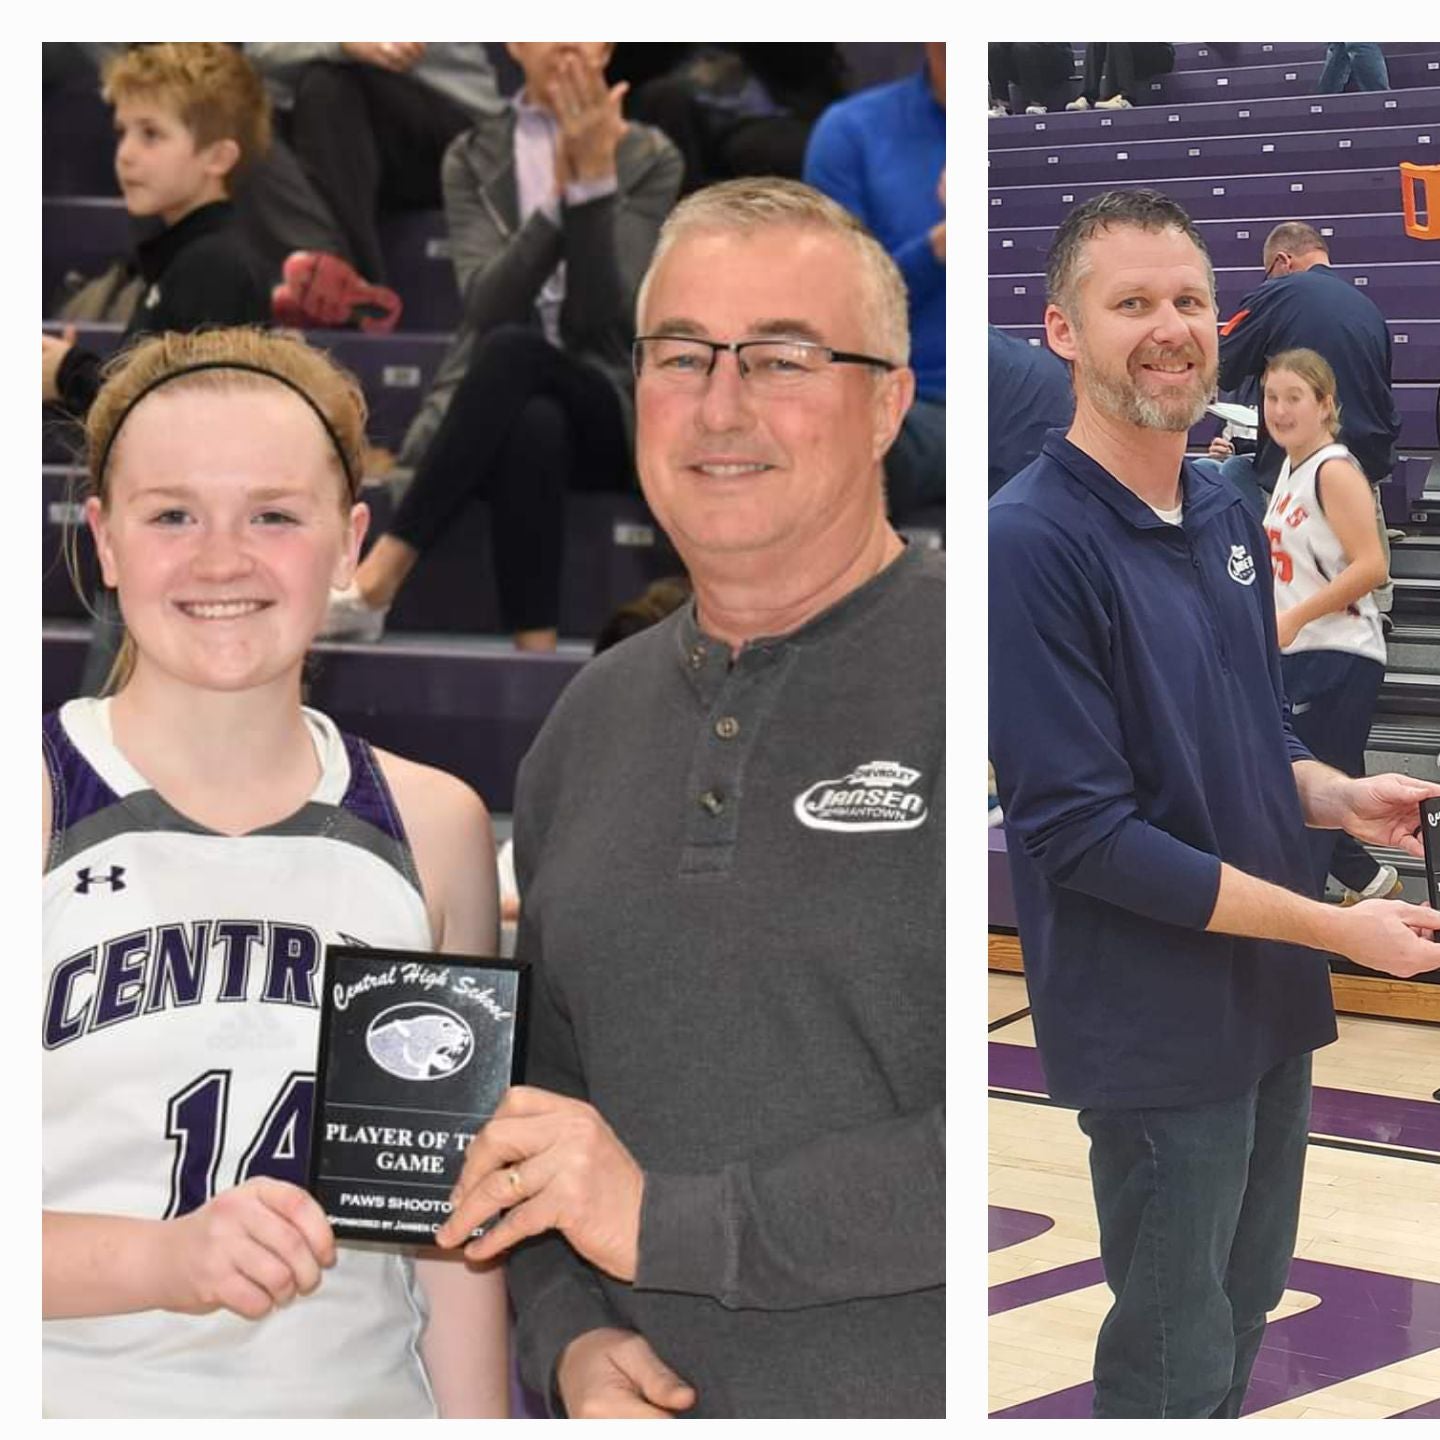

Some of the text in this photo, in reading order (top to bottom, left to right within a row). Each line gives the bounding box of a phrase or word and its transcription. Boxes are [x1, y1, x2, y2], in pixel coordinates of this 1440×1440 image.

[42, 918, 326, 1052] CENTR
[333, 963, 514, 1022] Central High School
[163, 1069, 315, 1220] 14
[325, 1122, 413, 1147] PLAYER
[417, 1129, 450, 1151] OF
[376, 1151, 445, 1174] GAME
[340, 1192, 453, 1212] PAWS SHOOTO
